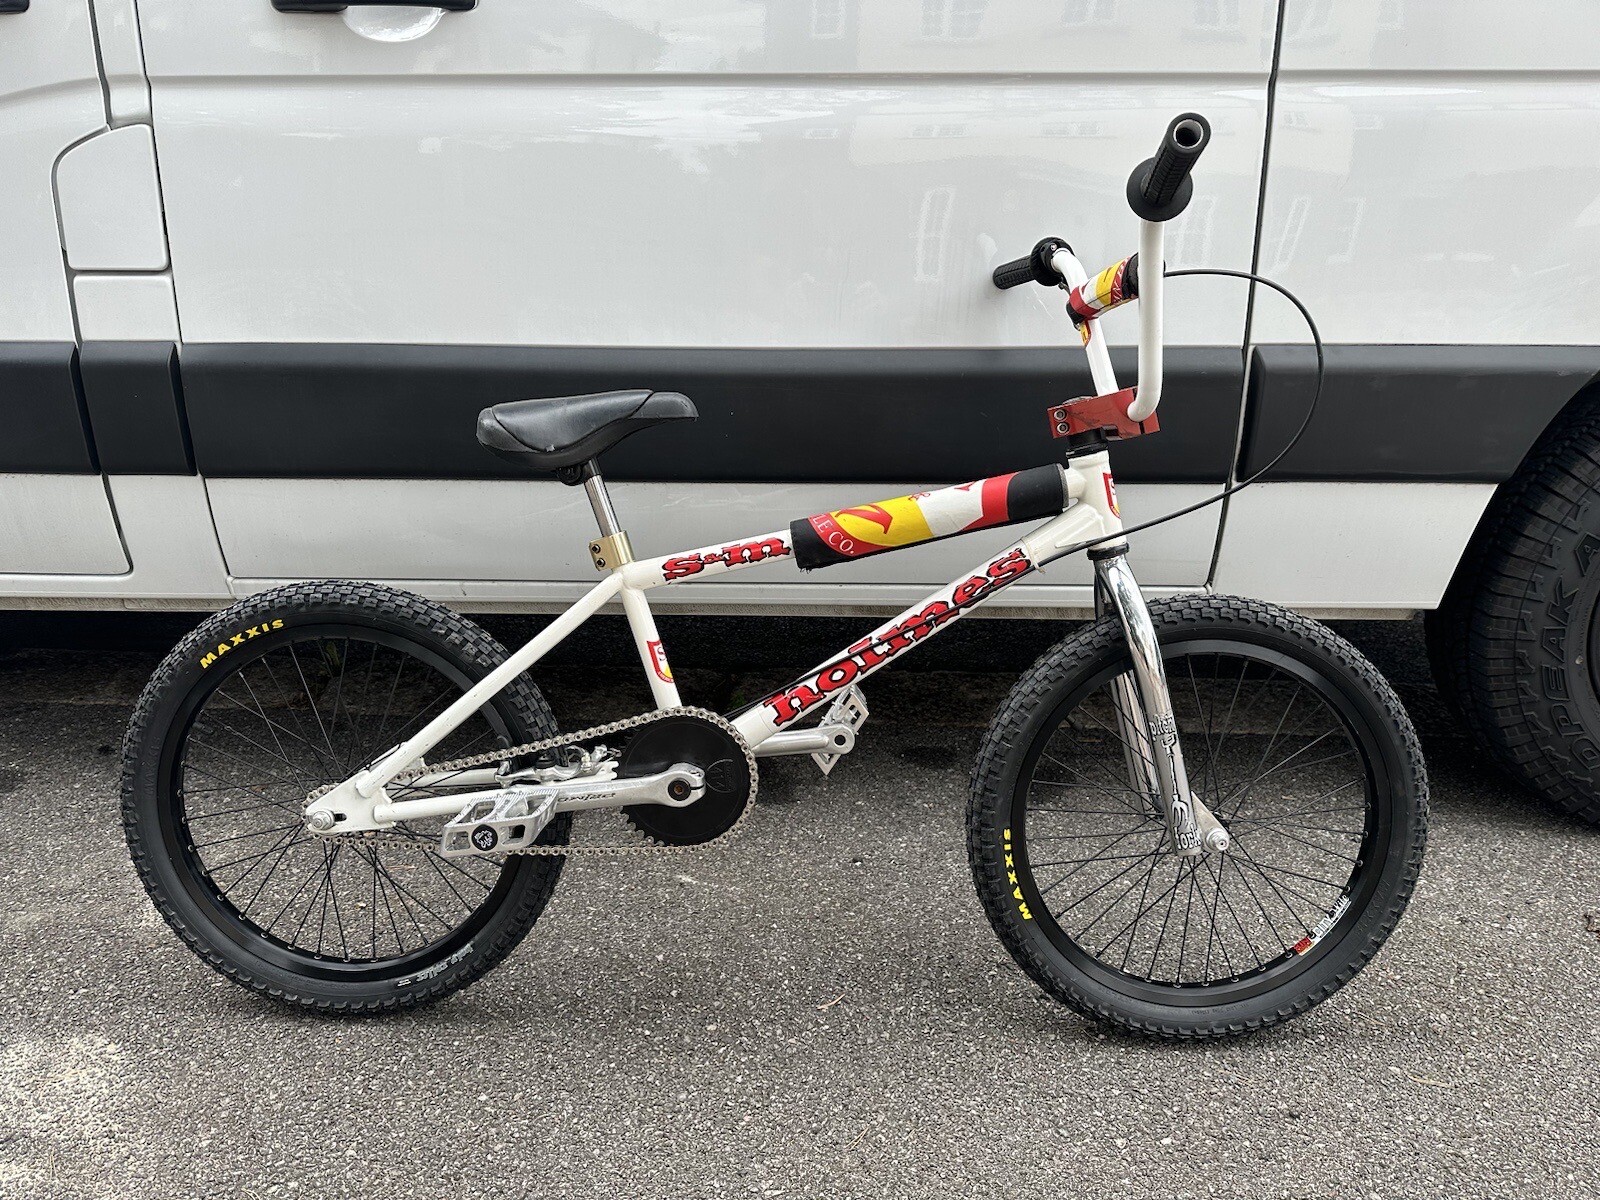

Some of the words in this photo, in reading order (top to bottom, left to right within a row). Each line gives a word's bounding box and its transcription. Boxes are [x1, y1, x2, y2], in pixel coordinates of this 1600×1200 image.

[828, 531, 855, 555] CO.
[199, 618, 285, 669] MAXXIS
[1003, 828, 1033, 920] MAXXIS
